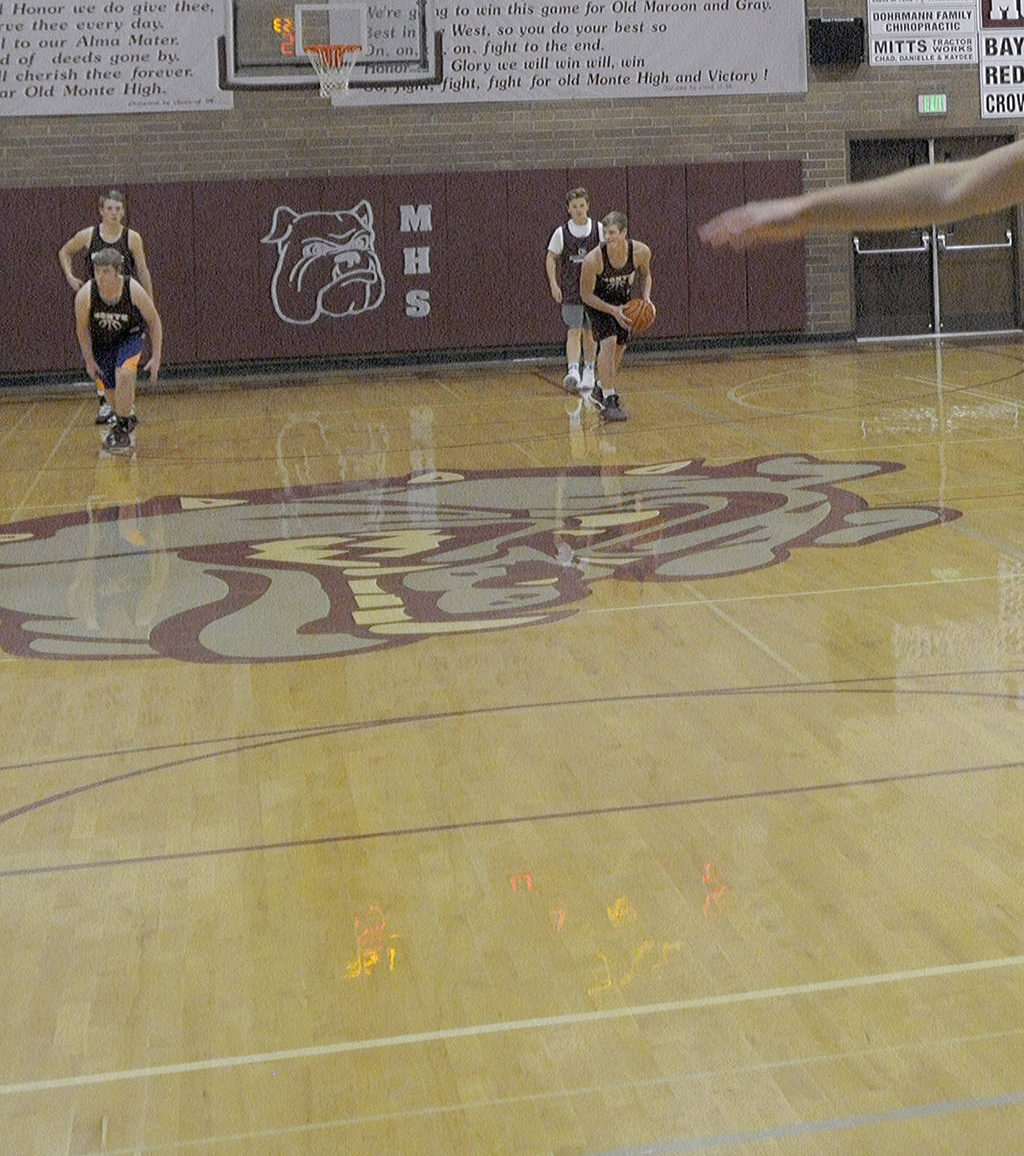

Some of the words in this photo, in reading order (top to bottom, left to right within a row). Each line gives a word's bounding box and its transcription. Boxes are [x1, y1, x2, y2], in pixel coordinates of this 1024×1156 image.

[13, 2, 65, 15] Honor
[73, 4, 96, 14] we
[104, 2, 124, 13] do
[133, 0, 168, 16] give
[455, 5, 470, 16] to
[476, 4, 501, 16] win
[508, 2, 534, 15] this
[541, 4, 580, 18] game
[585, 1, 606, 17] for
[612, 0, 637, 14] Old
[643, 0, 697, 13] Maroon
[873, 11, 933, 22] DOHRMANN
[936, 10, 972, 21] FAMILY
[497, 25, 514, 36] so
[520, 25, 545, 38] you
[551, 21, 569, 35] do
[576, 22, 608, 36] your
[614, 20, 644, 34] best
[651, 22, 668, 33] so
[885, 21, 961, 33] CHIROPRACTIC
[874, 39, 928, 54] MITTS
[932, 38, 973, 46] TRACTOR
[932, 45, 973, 53] WORKS
[450, 58, 491, 74] Glory
[498, 61, 517, 71] we
[524, 57, 549, 70] will
[556, 56, 580, 70] win
[621, 55, 645, 68] win
[15, 68, 78, 82] cherish
[86, 68, 121, 80] thee
[441, 76, 480, 92] fight,
[487, 75, 521, 92] fight
[529, 74, 551, 91] for
[558, 73, 580, 87] old
[587, 72, 631, 86] Monte
[637, 70, 669, 87] High
[675, 69, 702, 84] and
[708, 68, 758, 85] Victory
[25, 85, 54, 98] Old
[63, 84, 115, 97] Monte
[123, 82, 167, 97] High.
